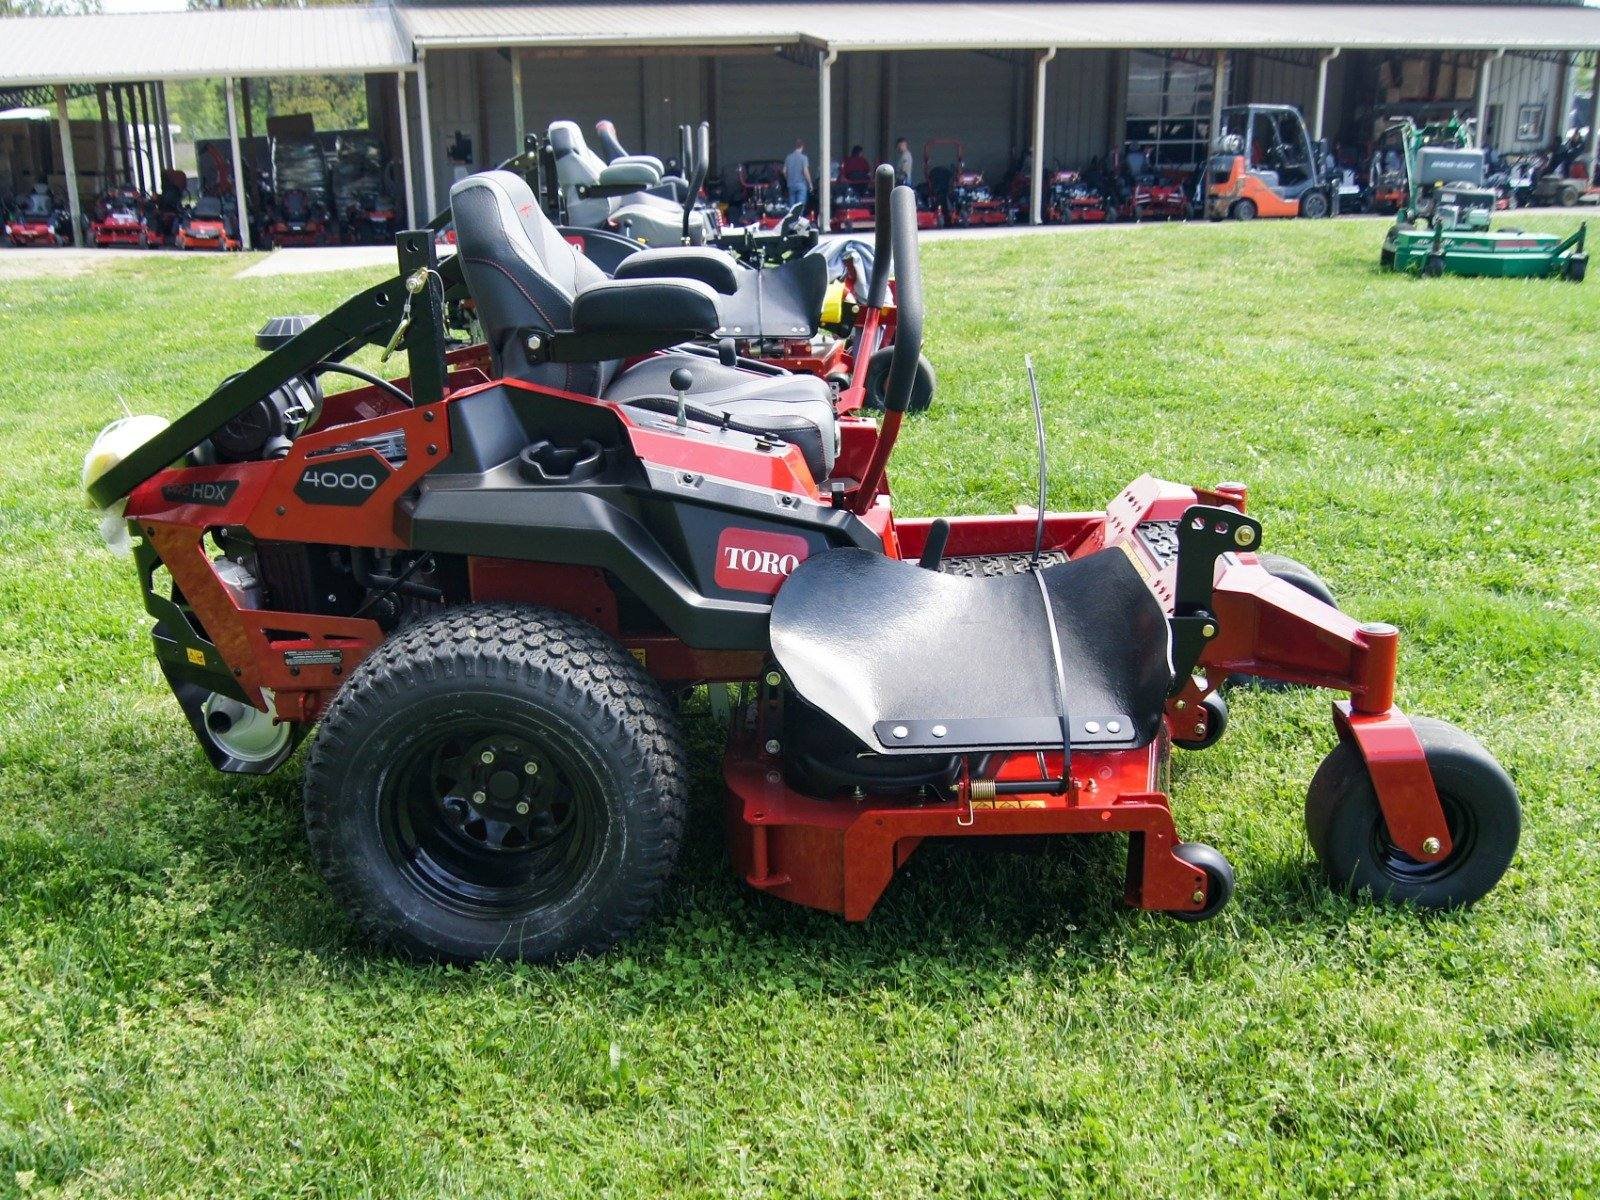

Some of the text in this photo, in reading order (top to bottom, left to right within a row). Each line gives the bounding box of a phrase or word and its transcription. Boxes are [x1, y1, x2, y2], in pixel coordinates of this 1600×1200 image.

[302, 471, 376, 490] 4000
[193, 484, 226, 501] HDX
[724, 546, 800, 576] TORO
